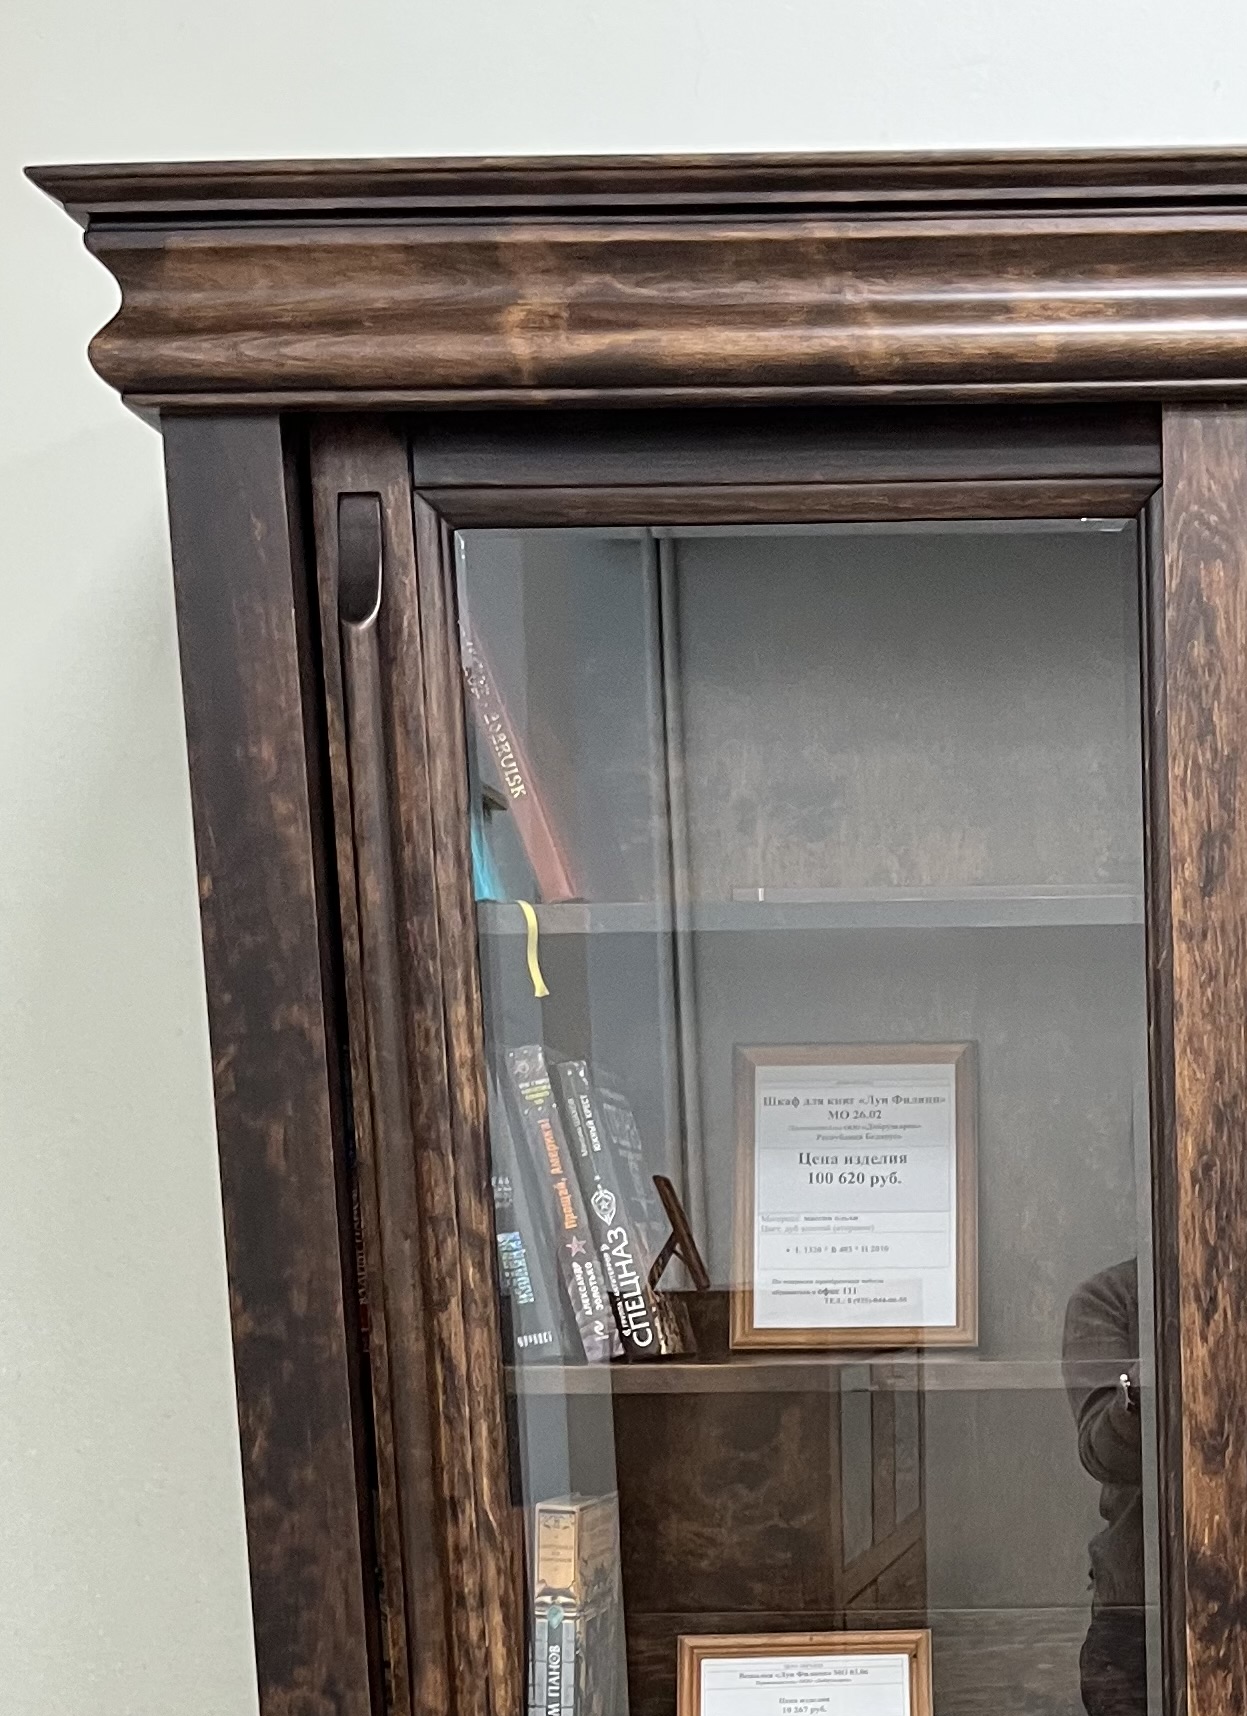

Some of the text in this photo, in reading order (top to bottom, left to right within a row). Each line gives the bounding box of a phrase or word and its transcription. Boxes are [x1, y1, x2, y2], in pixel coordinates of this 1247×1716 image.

[763, 1096, 800, 1108] Шкаф
[827, 1109, 882, 1120] МО 26.02
[798, 1152, 908, 1166] Цена изделия
[808, 1171, 902, 1188] 100 620 руб.
[571, 1260, 593, 1316] АЛЕКСАНДР
[607, 1226, 654, 1348] СПЕЦНАЗ
[547, 1644, 561, 1699] ПАНОВ
